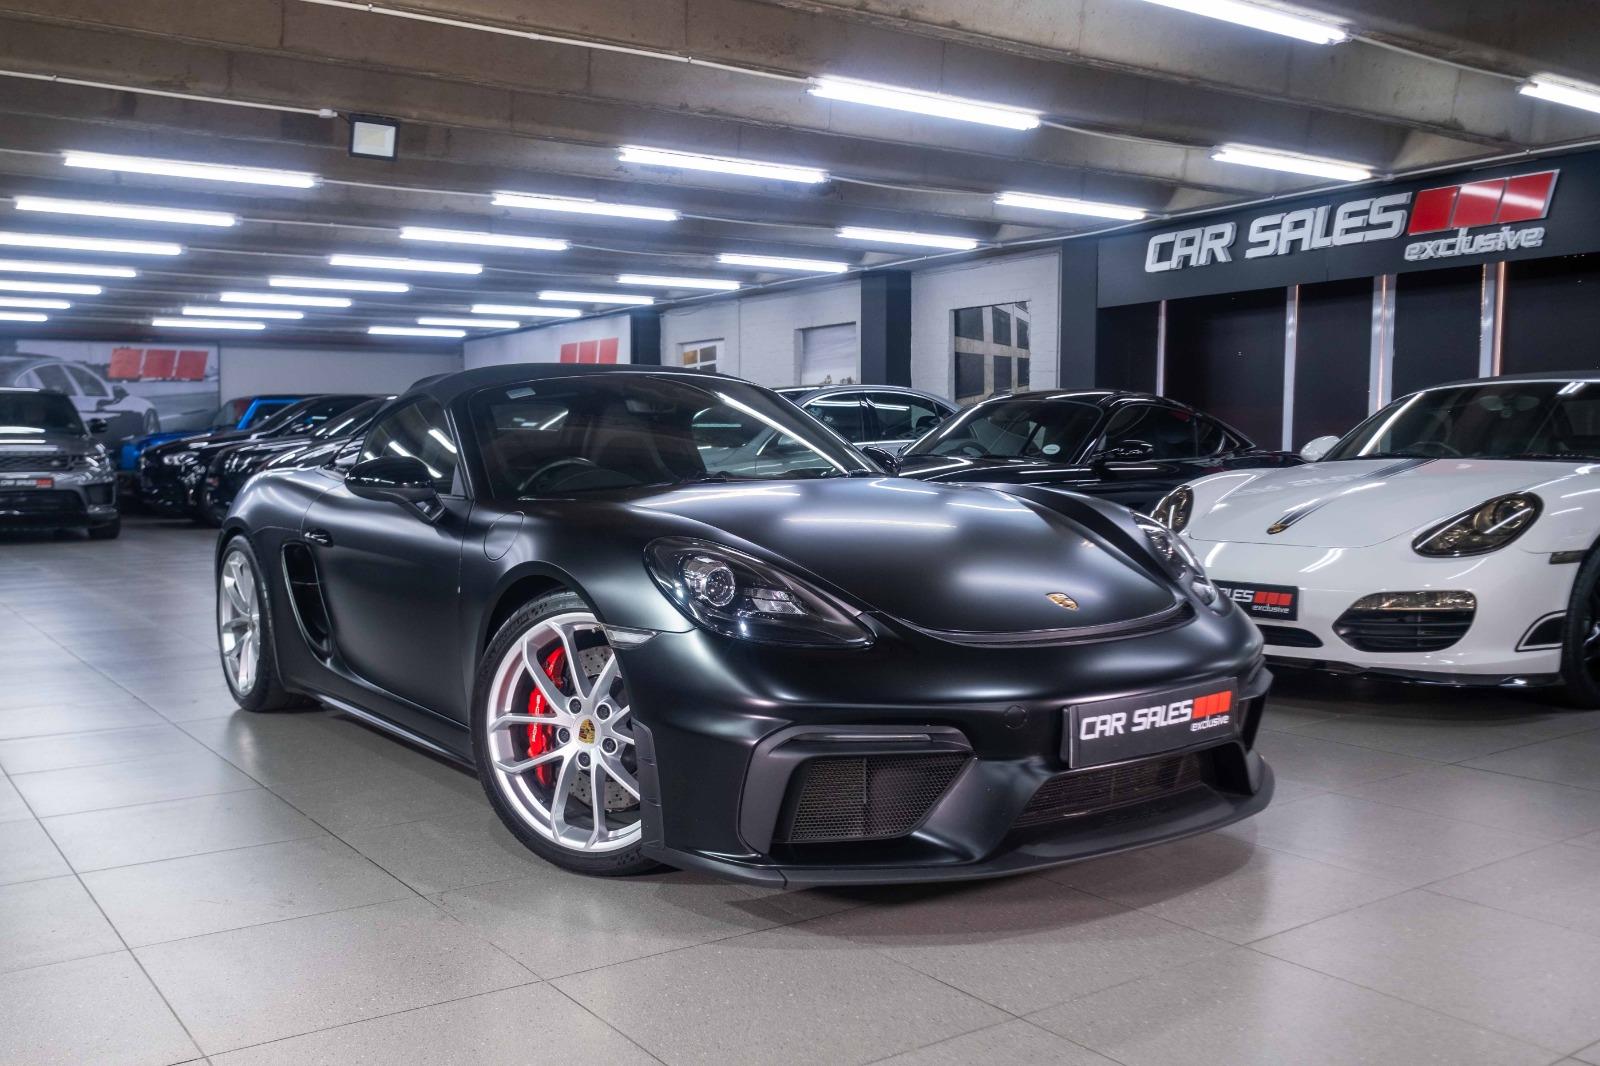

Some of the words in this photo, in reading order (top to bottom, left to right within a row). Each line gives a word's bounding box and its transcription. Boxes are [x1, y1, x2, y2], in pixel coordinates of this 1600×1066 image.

[1145, 221, 1236, 273] CAR
[1245, 192, 1411, 259] SALES
[1404, 226, 1545, 261] exclusive
[1252, 603, 1289, 613] exclusive
[1080, 712, 1126, 739] CAR
[1131, 700, 1193, 732] SALES
[1190, 715, 1229, 732] exclusive
